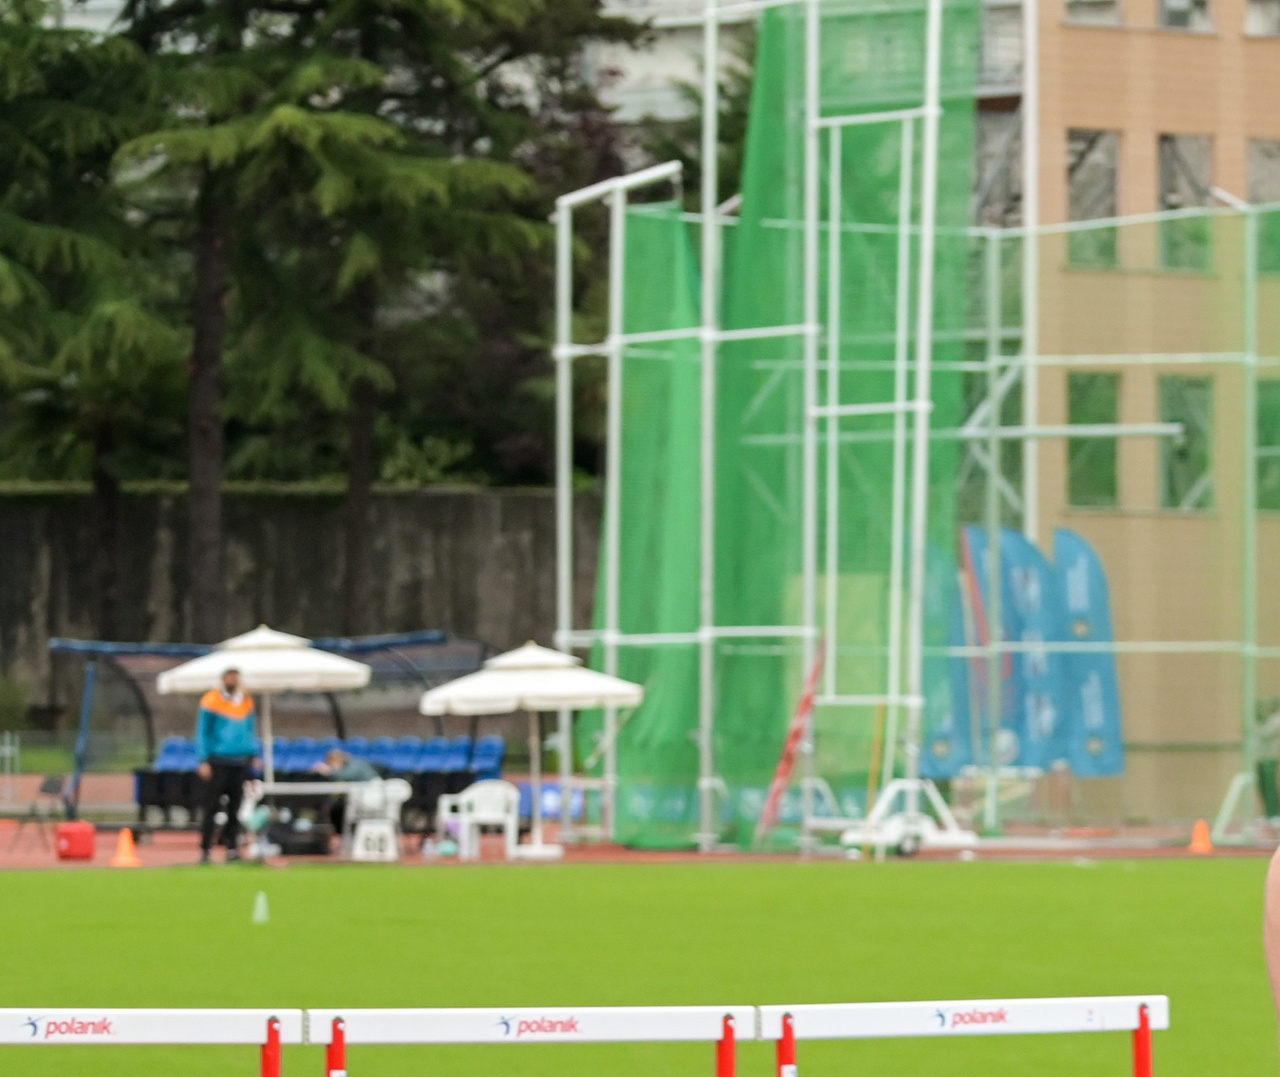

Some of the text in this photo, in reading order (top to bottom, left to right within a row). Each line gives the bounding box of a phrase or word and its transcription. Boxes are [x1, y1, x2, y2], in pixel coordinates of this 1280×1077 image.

[45, 1017, 112, 1039] polanik
[517, 1016, 578, 1037] polanik
[951, 1008, 1007, 1028] polanik
